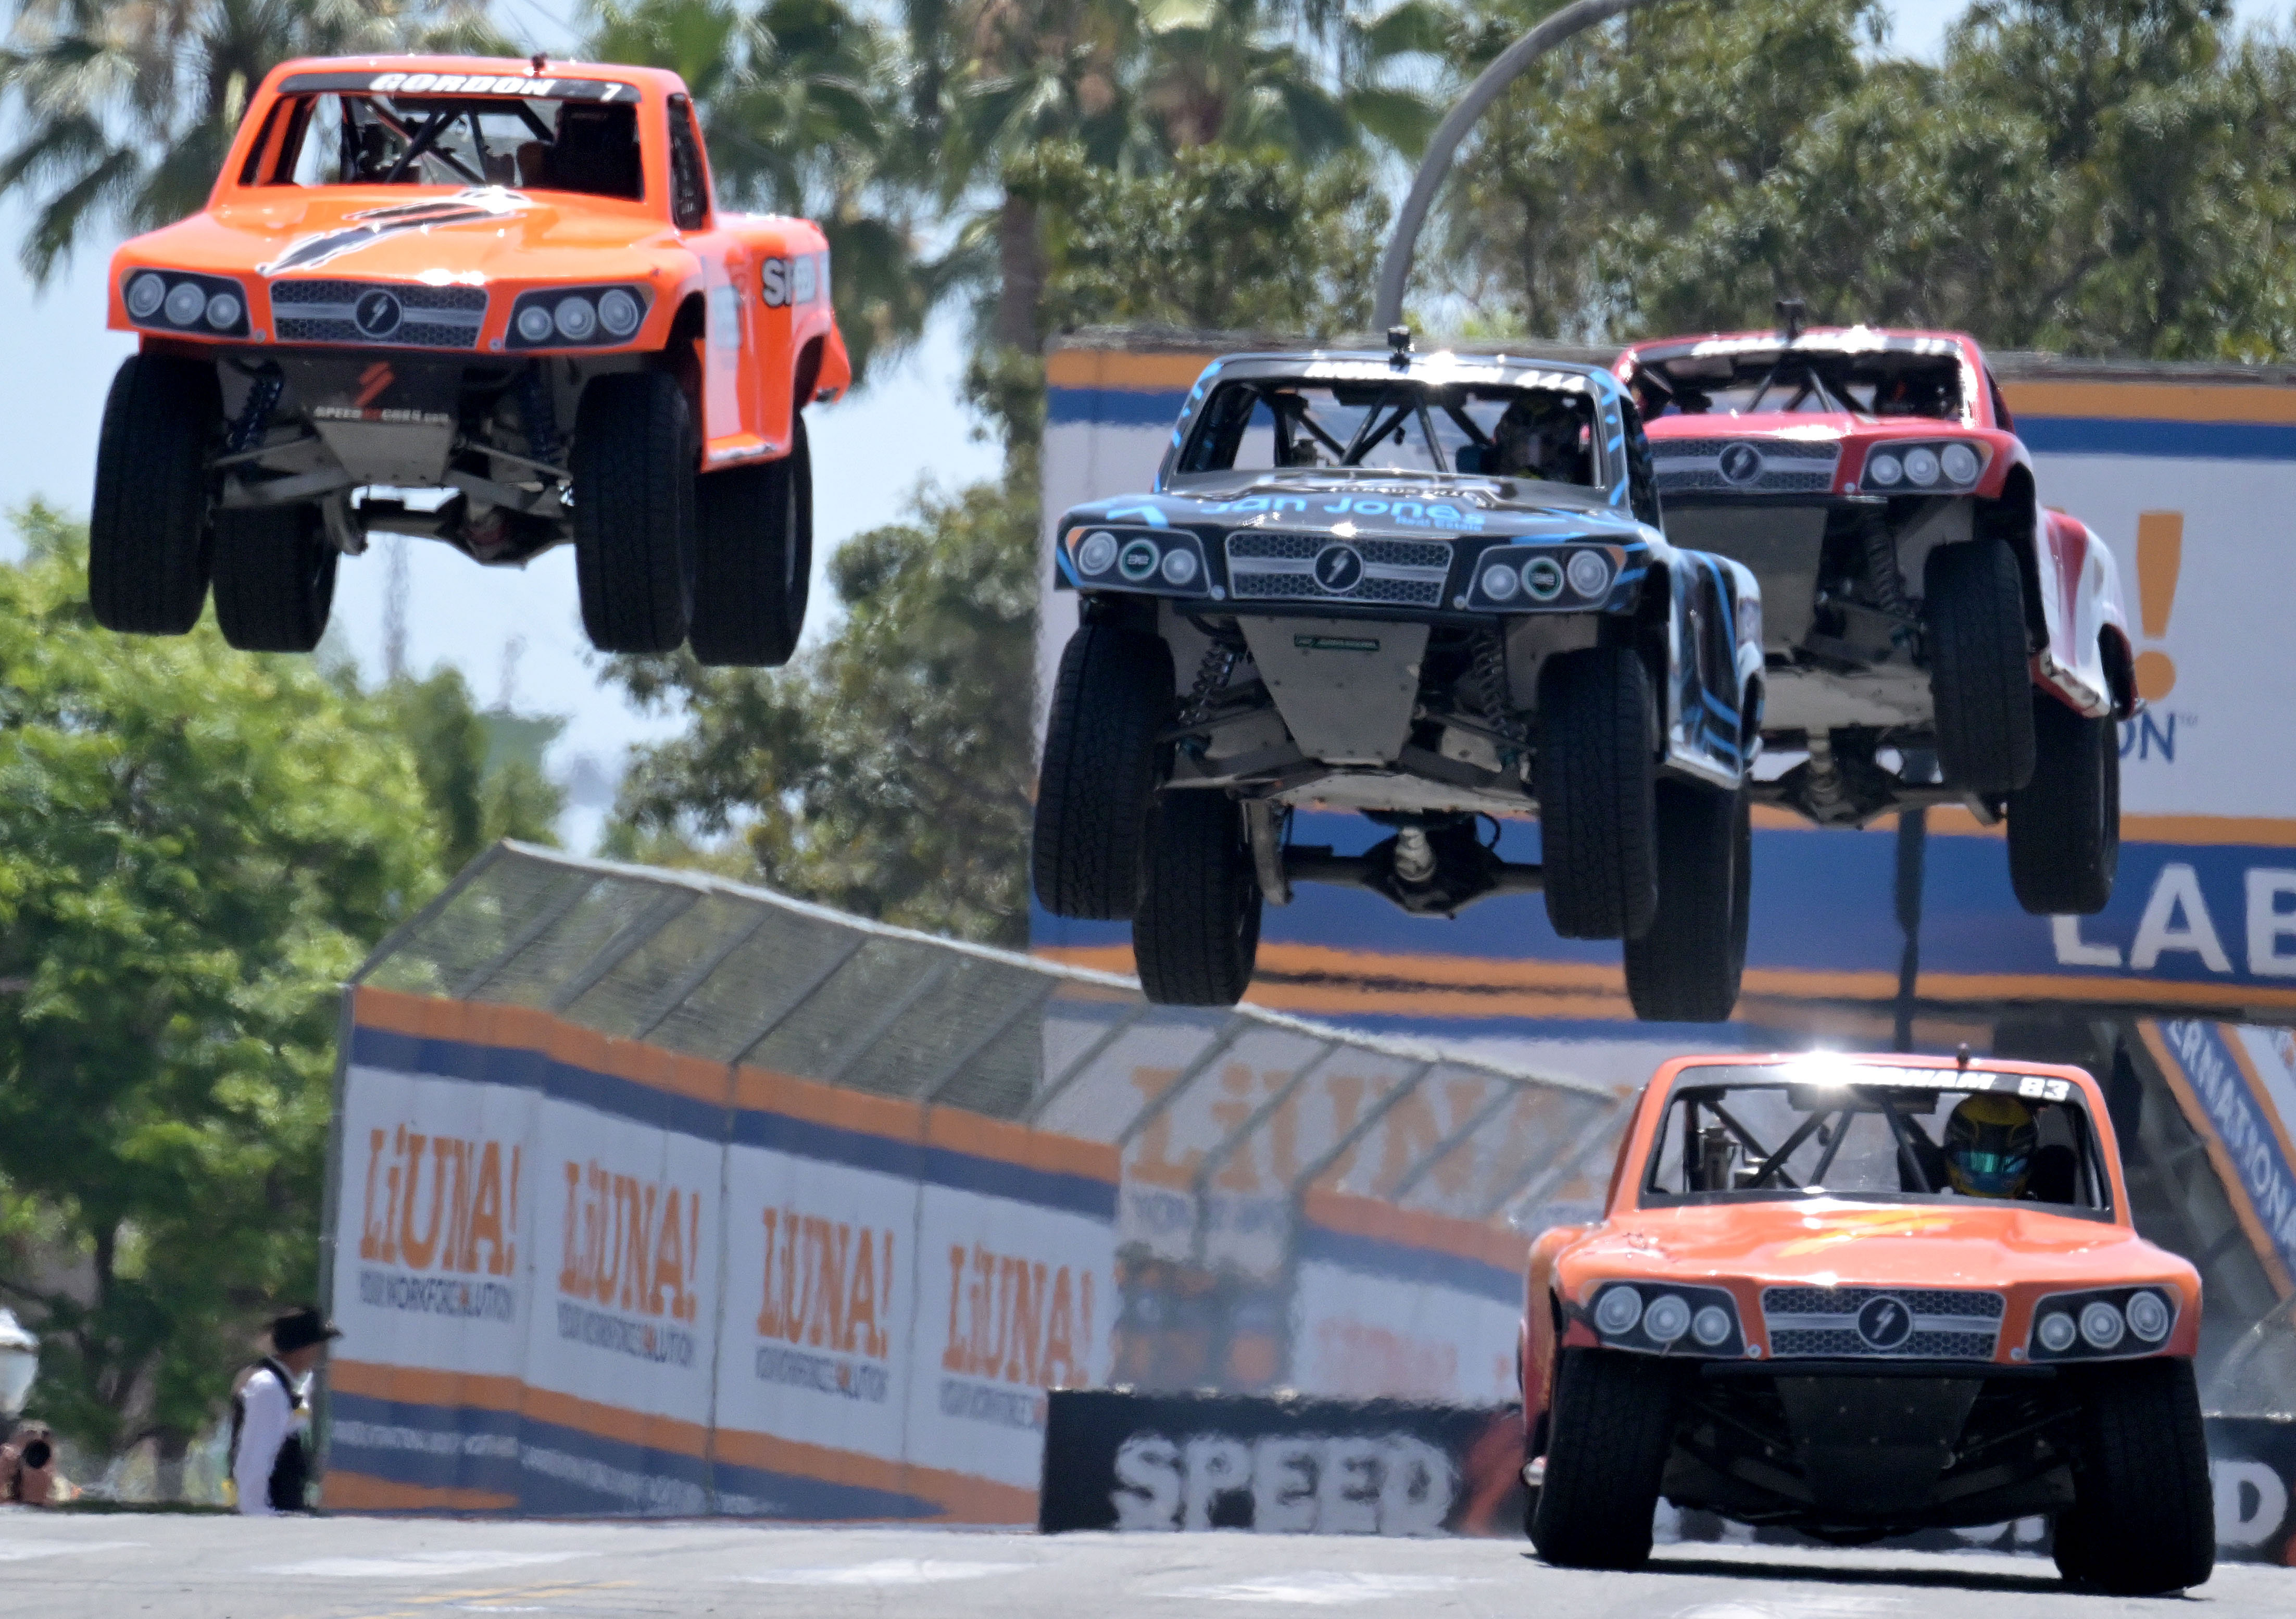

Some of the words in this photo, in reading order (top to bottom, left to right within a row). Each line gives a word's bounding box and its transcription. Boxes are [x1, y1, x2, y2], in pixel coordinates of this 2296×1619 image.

[369, 72, 557, 96] GORDON
[1323, 496, 1486, 525] Jones
[2018, 1076, 2071, 1102] 83
[359, 1122, 521, 1277] LiUNA!
[1110, 1430, 1458, 1537] SPEED
